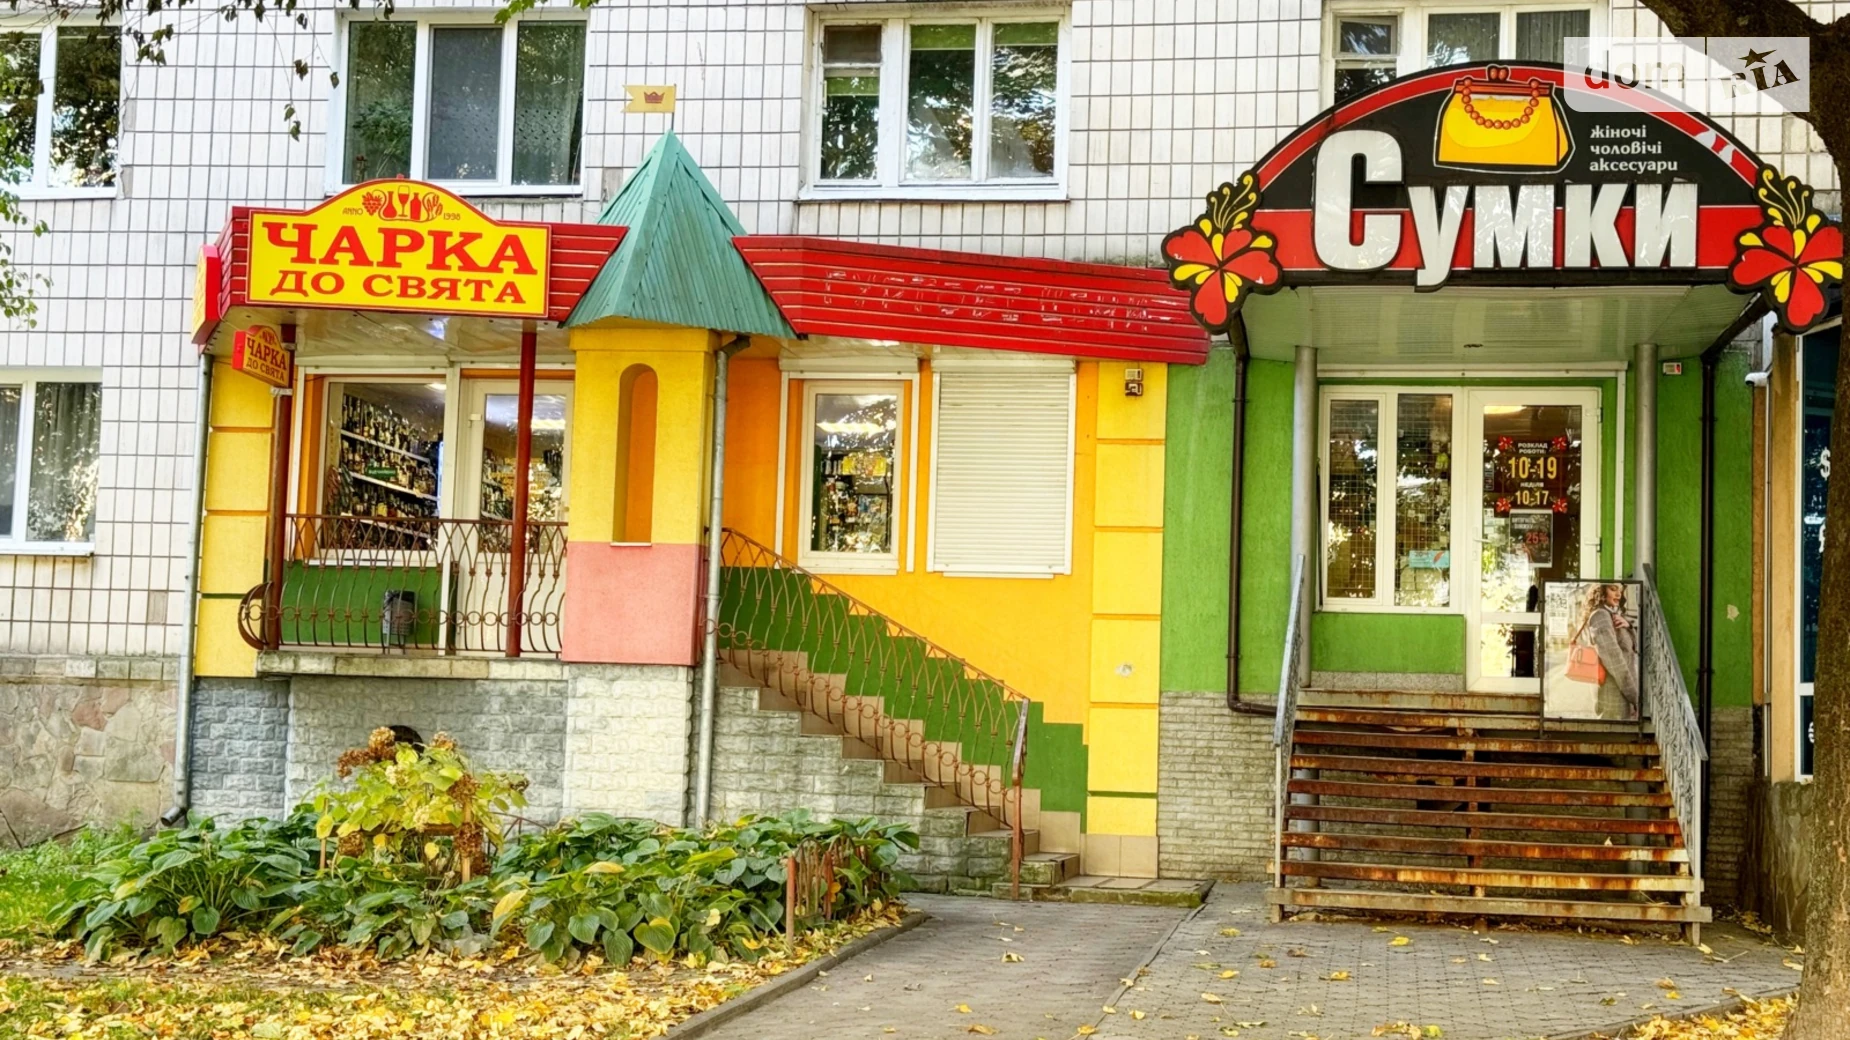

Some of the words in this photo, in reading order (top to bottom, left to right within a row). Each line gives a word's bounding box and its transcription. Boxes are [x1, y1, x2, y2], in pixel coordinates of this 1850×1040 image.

[1590, 124, 1647, 140] жіночі
[1590, 140, 1663, 155] чоловічі
[1589, 157, 1679, 174] аксесуари
[342, 206, 364, 216] ANNO
[443, 212, 461, 221] 1998
[1313, 128, 1698, 292] Сумки
[262, 221, 538, 276] ЧАРКА
[269, 269, 345, 297] ДО
[362, 273, 526, 305] СВЯТА
[247, 337, 287, 370] ЧАРКА
[246, 357, 259, 369] ДО
[260, 362, 285, 381] СВЯТА
[1508, 456, 1557, 479] 10-19
[1515, 490, 1549, 505] 10-17
[1525, 531, 1549, 546] 25%
